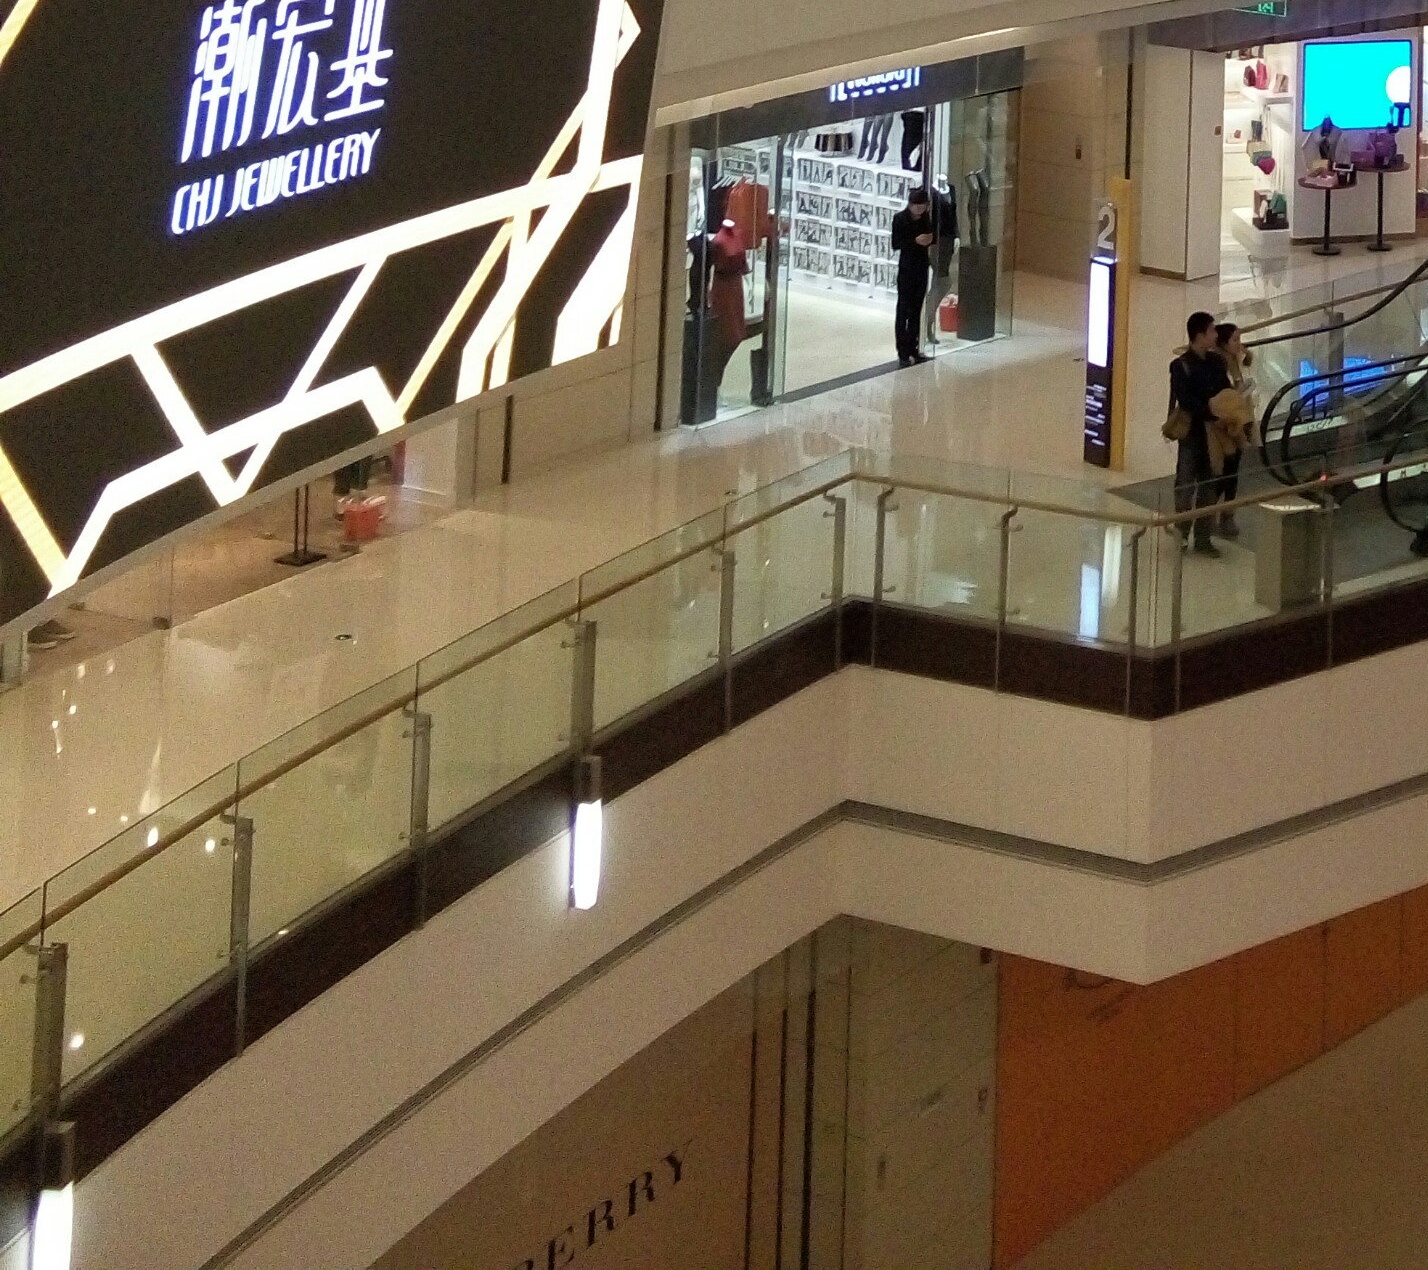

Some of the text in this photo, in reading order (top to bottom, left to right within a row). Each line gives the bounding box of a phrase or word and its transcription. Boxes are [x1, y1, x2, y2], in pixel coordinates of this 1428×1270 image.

[171, 127, 382, 235] CHJ JEWELLERY
[1096, 205, 1116, 250] 2
